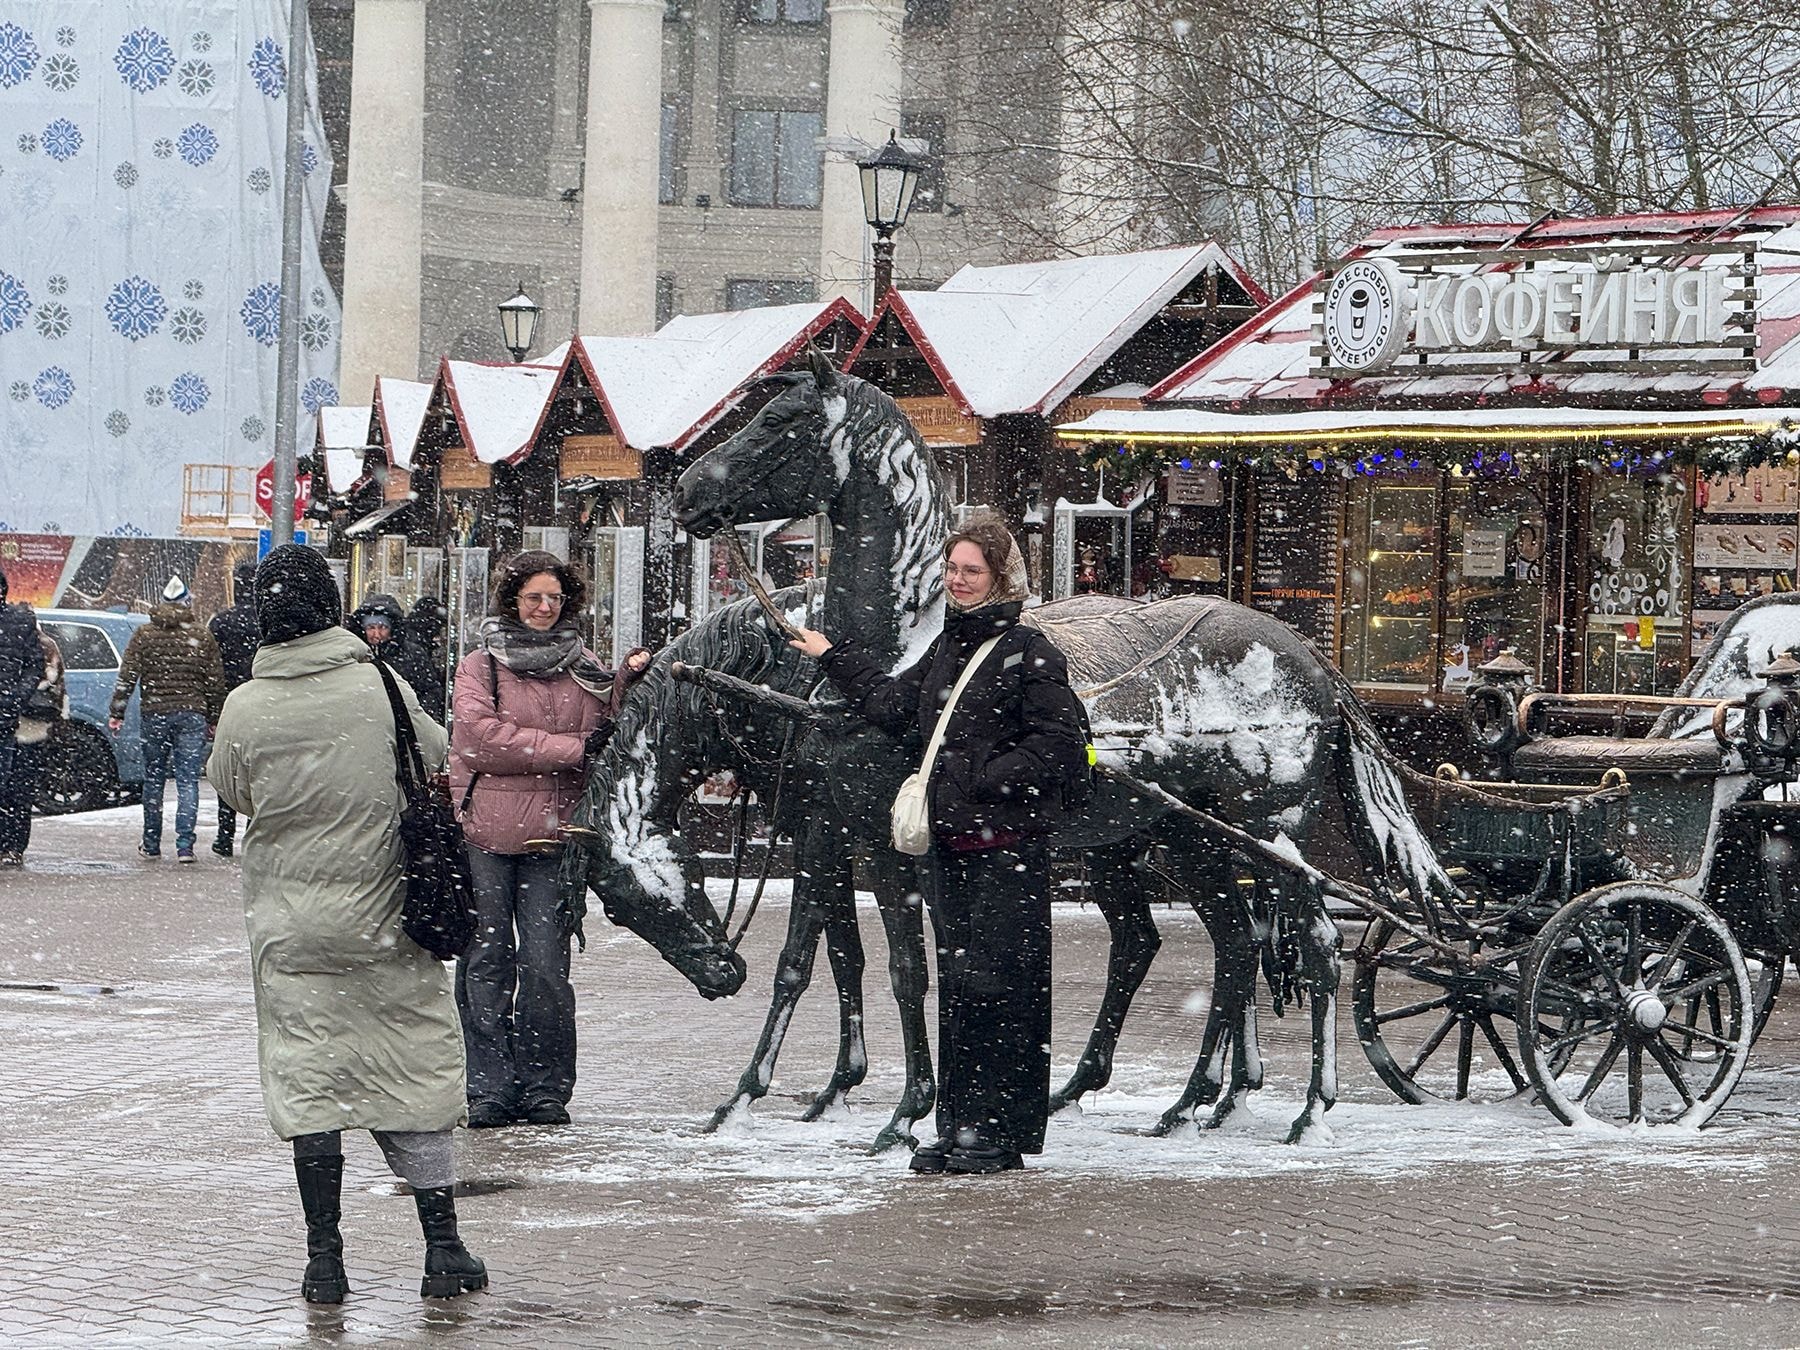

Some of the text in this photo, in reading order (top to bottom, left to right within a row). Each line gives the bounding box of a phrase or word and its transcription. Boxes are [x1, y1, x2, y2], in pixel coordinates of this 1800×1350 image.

[1329, 271, 1352, 310] КОФЕ
[1353, 266, 1361, 277] С
[1415, 252, 1710, 347] КОФЕЙНЯ
[1328, 325, 1388, 364] COFFEE TO GO
